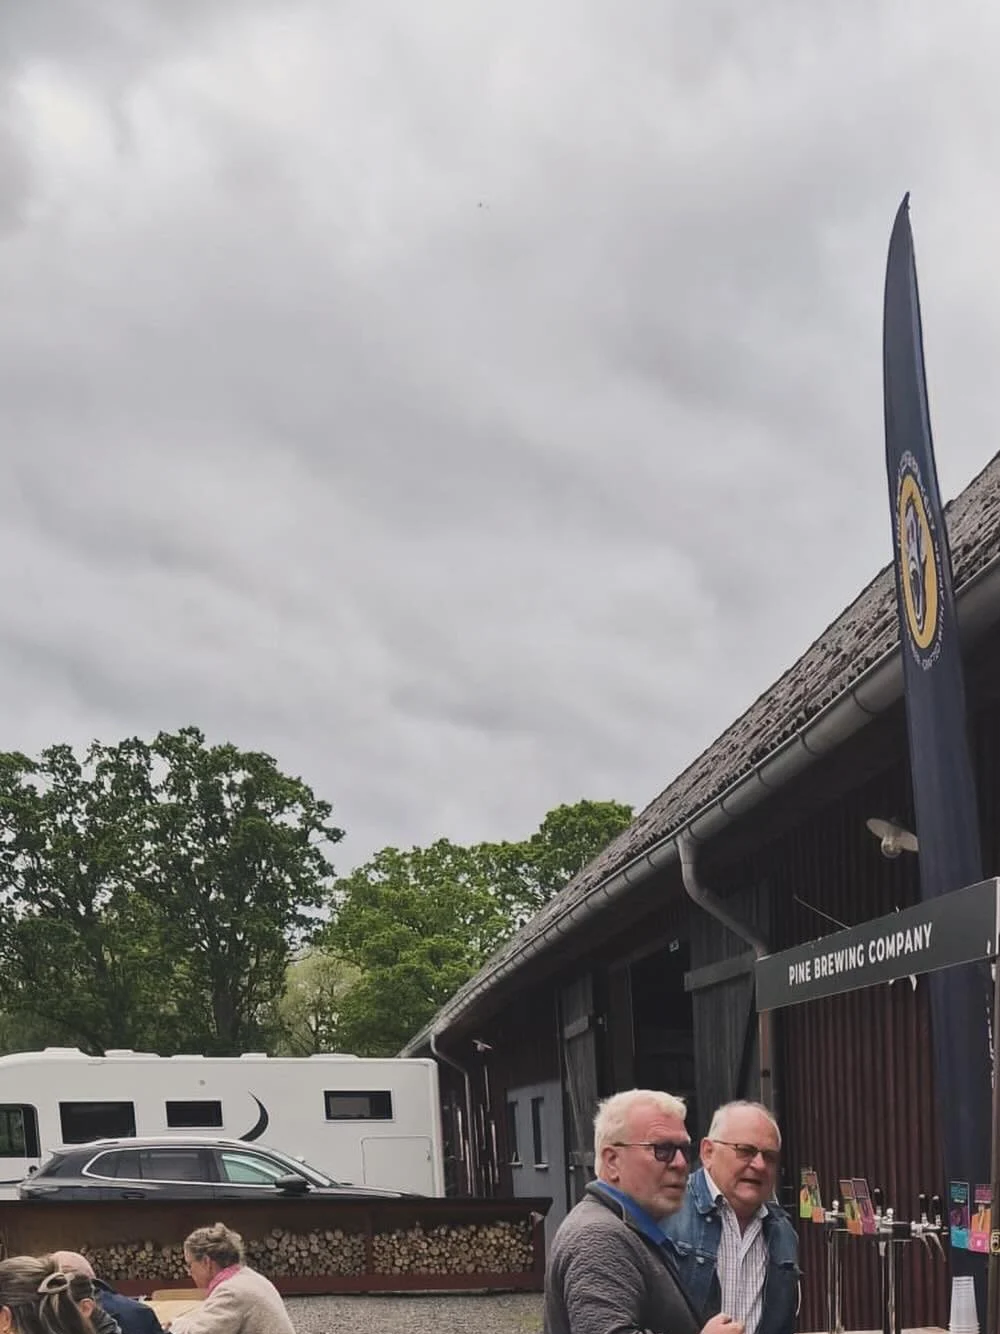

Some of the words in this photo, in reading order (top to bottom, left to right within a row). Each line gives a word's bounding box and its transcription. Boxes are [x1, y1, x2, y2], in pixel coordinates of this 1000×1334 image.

[788, 960, 811, 986] PINE
[814, 944, 864, 979] BREWING
[868, 922, 932, 964] COMPANY
